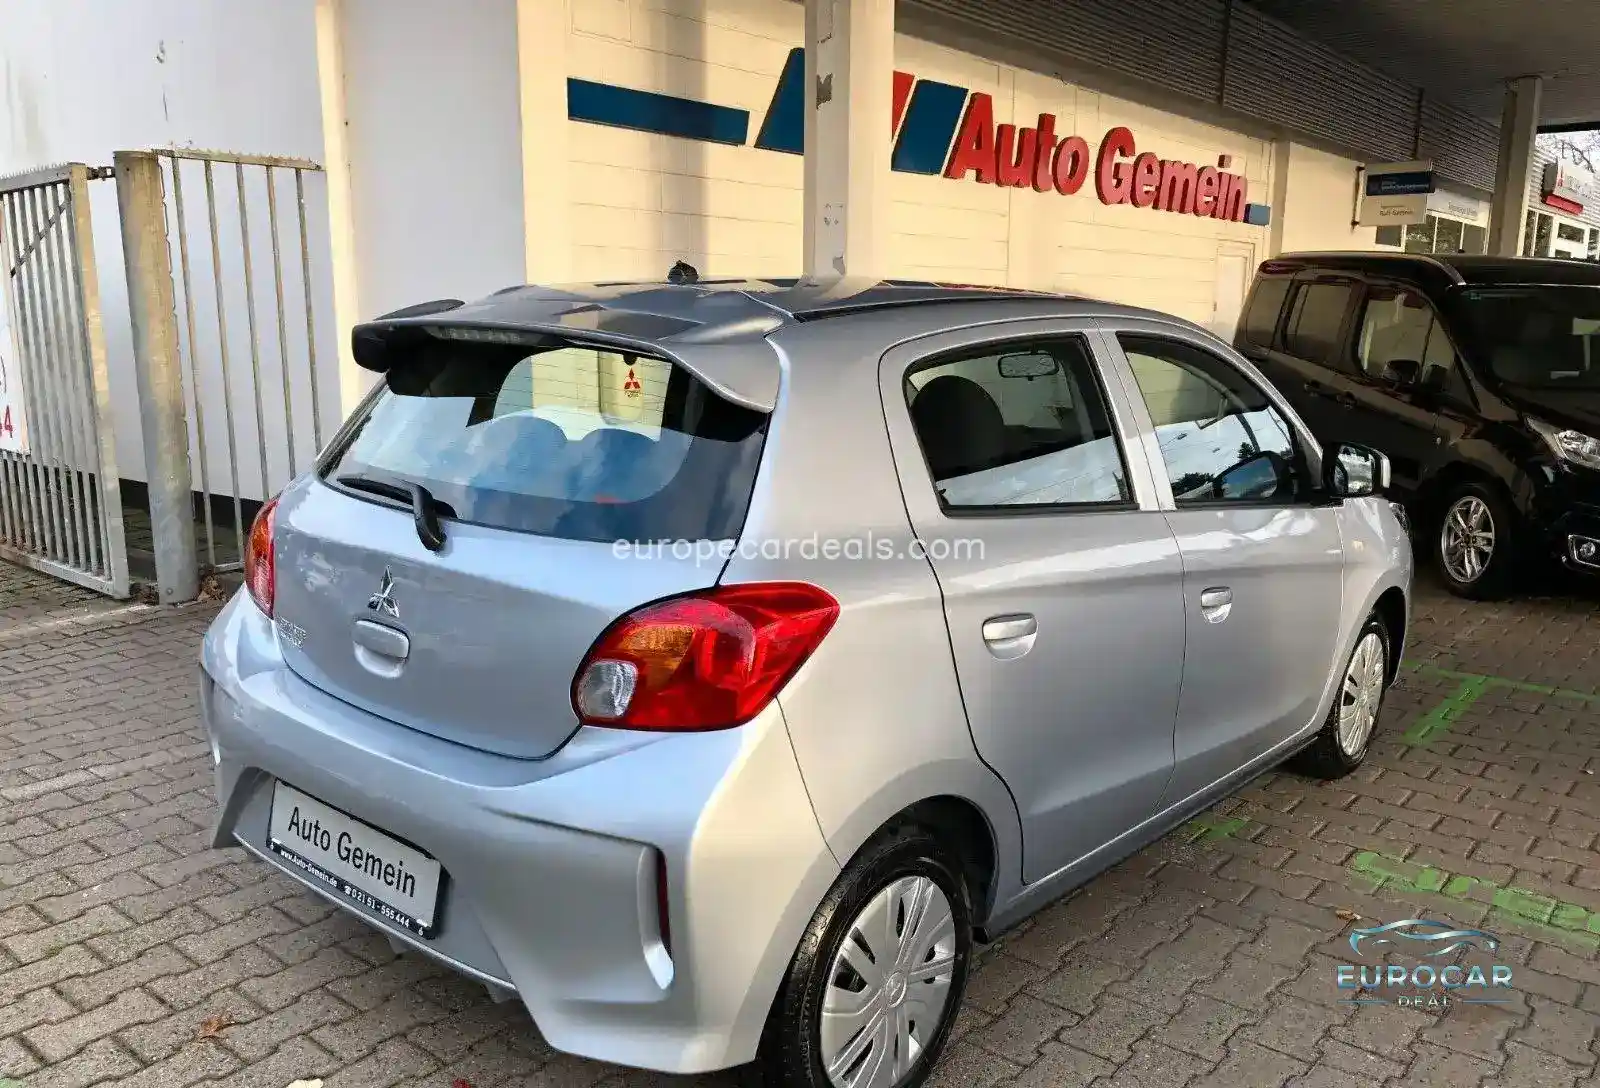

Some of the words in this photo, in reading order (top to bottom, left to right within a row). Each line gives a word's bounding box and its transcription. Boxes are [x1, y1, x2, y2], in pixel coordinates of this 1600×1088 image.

[943, 92, 1089, 195] Auto
[1095, 127, 1248, 222] Gemein
[288, 806, 331, 851] Auto
[337, 831, 416, 898] Gemein
